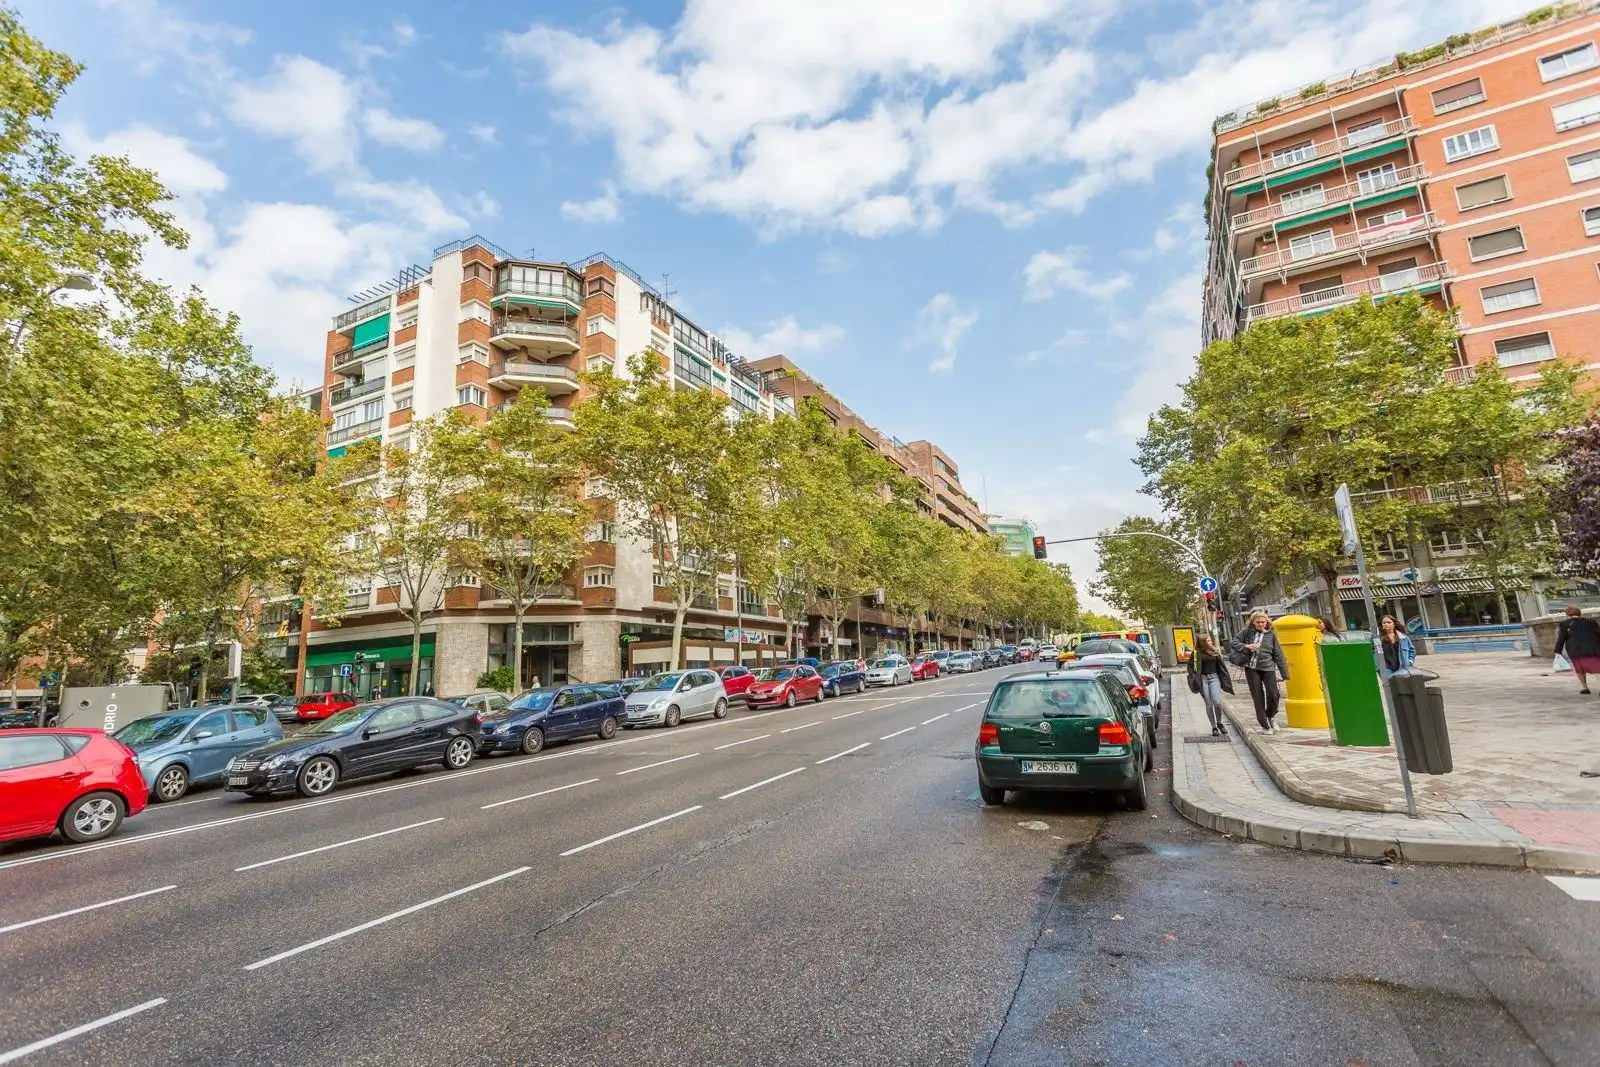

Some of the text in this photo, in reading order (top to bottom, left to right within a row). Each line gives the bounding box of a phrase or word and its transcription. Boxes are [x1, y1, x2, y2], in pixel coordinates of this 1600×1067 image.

[104, 704, 117, 733] IDRIO
[1037, 762, 1060, 771] 2636
[1063, 763, 1076, 772] YK
